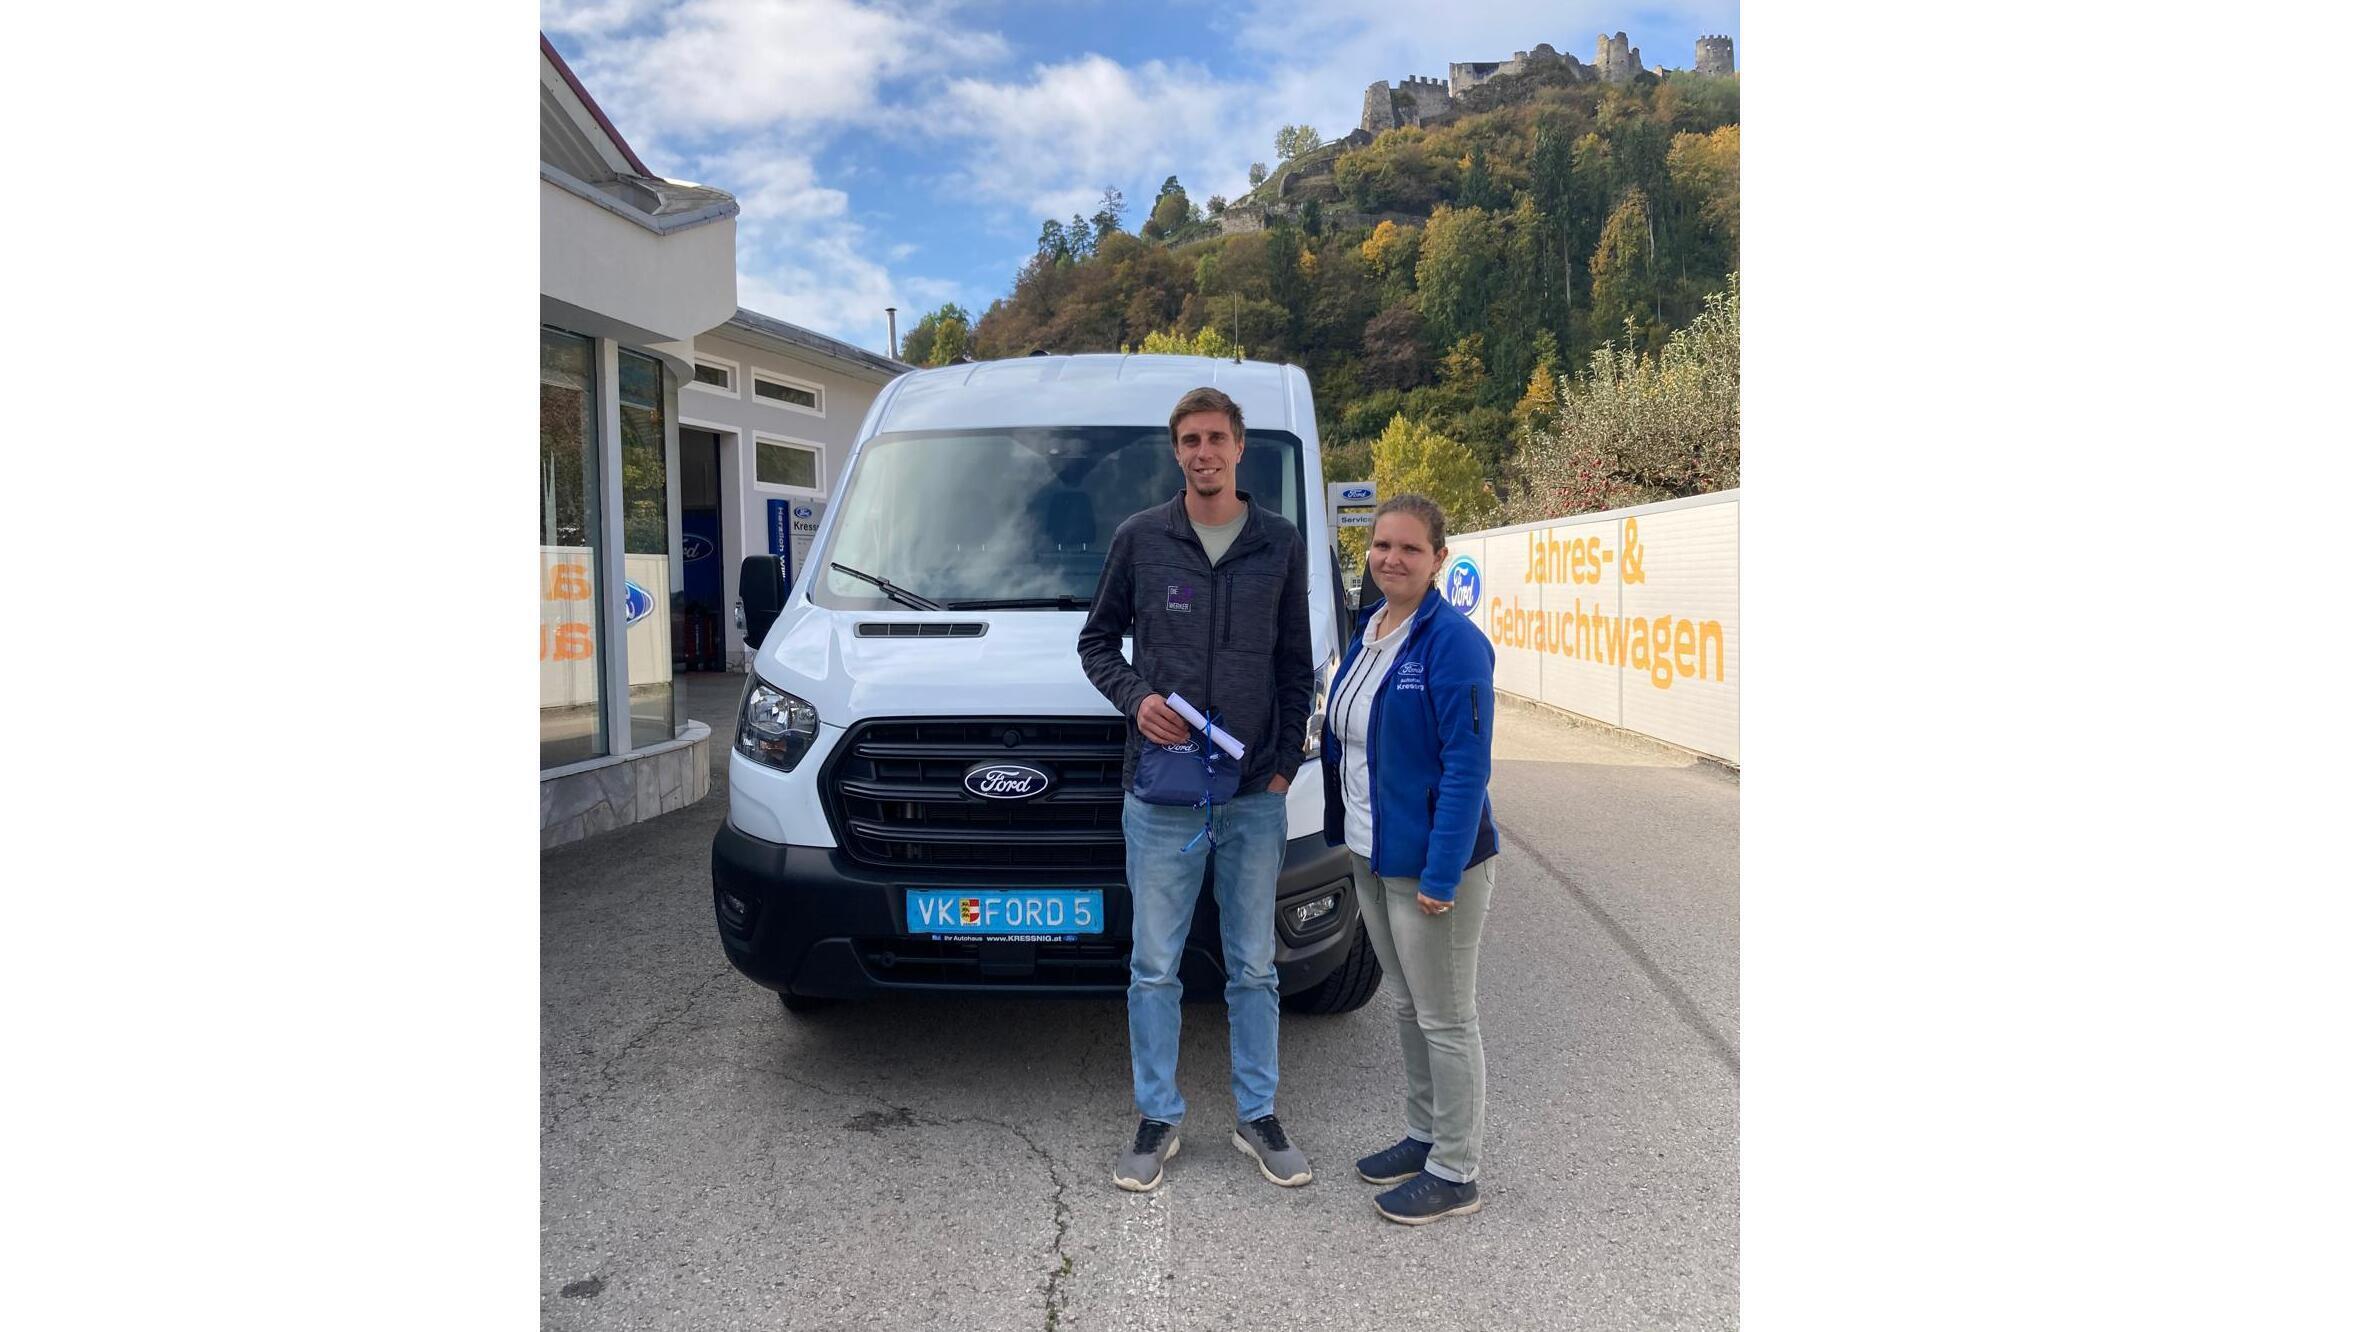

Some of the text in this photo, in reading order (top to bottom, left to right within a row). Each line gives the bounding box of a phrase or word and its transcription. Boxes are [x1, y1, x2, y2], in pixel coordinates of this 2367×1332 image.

[1525, 515, 1646, 585] Jahres- &
[1451, 568, 1476, 607] Ford
[1490, 596, 1724, 689] Gebrauchtwagen
[980, 770, 1031, 793] Ford
[918, 897, 1092, 926] VK FORD 5
